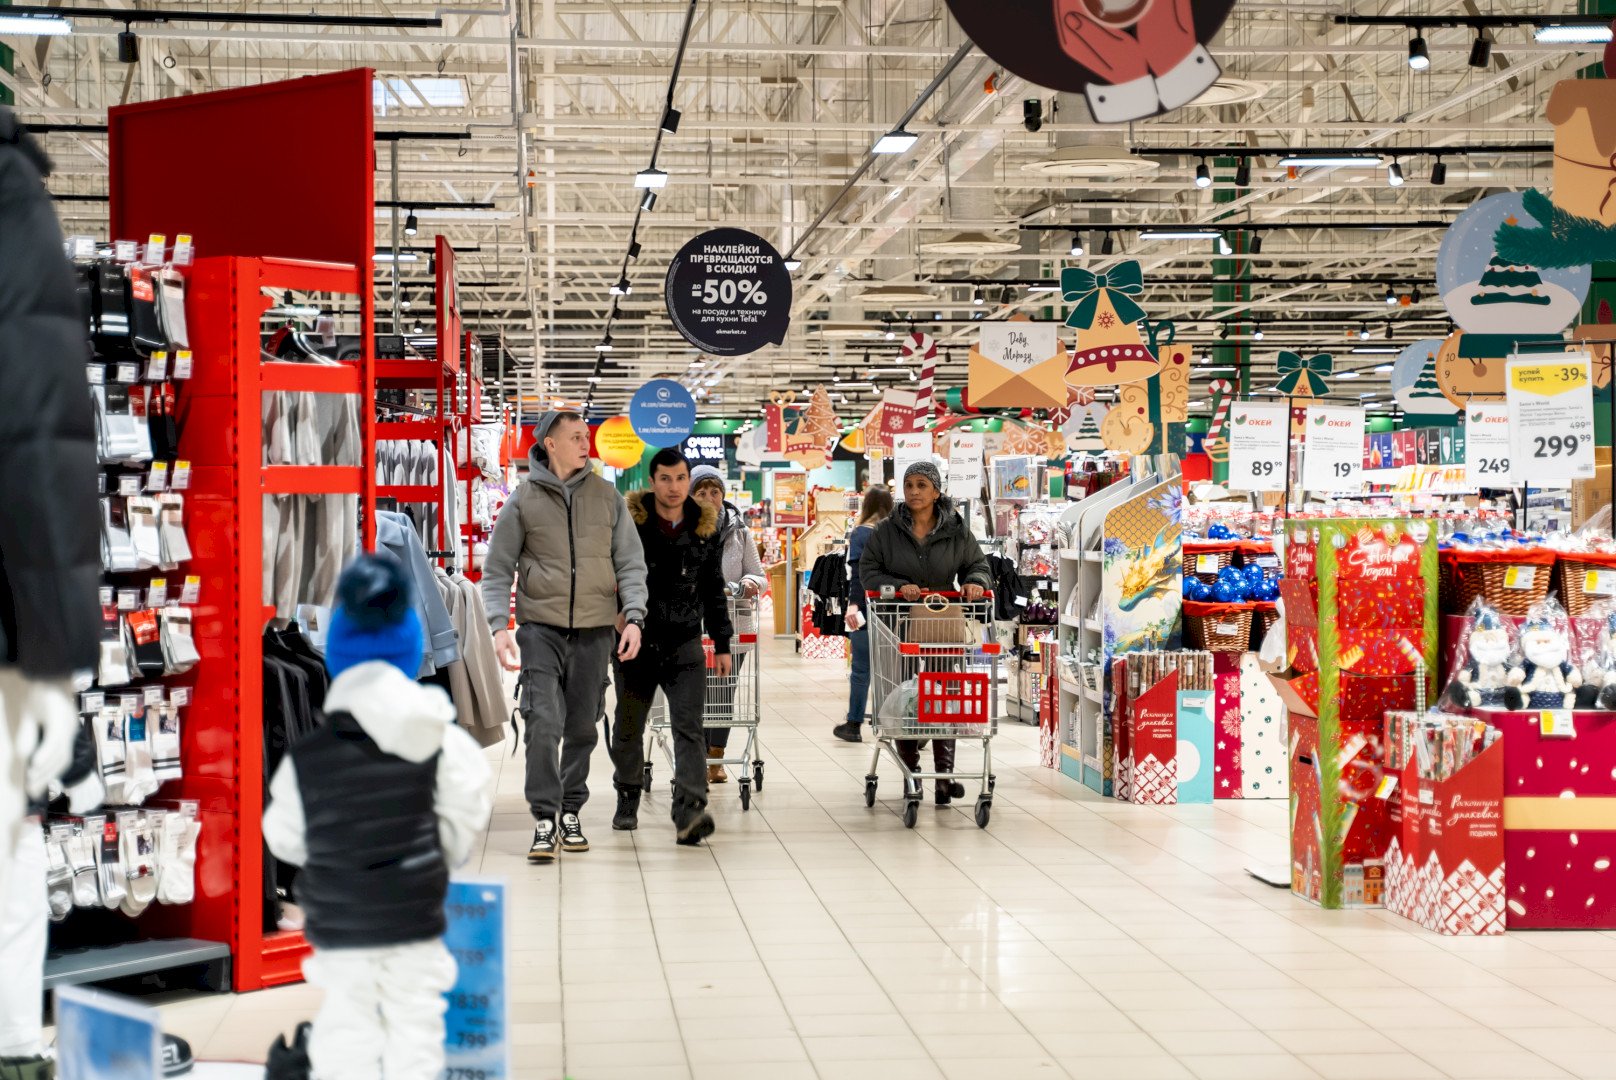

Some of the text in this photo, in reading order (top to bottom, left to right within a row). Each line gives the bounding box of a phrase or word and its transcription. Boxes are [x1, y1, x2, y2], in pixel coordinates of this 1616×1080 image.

[703, 244, 760, 254] НАКЛЕЙКИ
[690, 255, 773, 264] ПРЕВРАЩАЮТСЯ
[706, 264, 757, 274] В СКИДКИ
[691, 279, 768, 305] -50%
[740, 315, 758, 323] Tefal
[1002, 347, 1034, 364] Морозу
[1445, 352, 1456, 363] 10
[1444, 370, 1450, 379] 9
[1518, 368, 1541, 376] успей
[1451, 385, 1457, 395] 8
[687, 436, 721, 448] ОЧКИ
[1533, 434, 1592, 458] 299 99
[684, 447, 724, 459] ЗА ЧАС
[1251, 461, 1274, 477] 89
[1333, 462, 1352, 478] 19
[1478, 458, 1510, 474] 249
[1359, 562, 1398, 581] Годом!
[1136, 717, 1174, 730] упаковка
[1450, 794, 1500, 810] Роскошная
[1445, 806, 1501, 827] упаковка
[1468, 830, 1498, 838] ПОДАРКА
